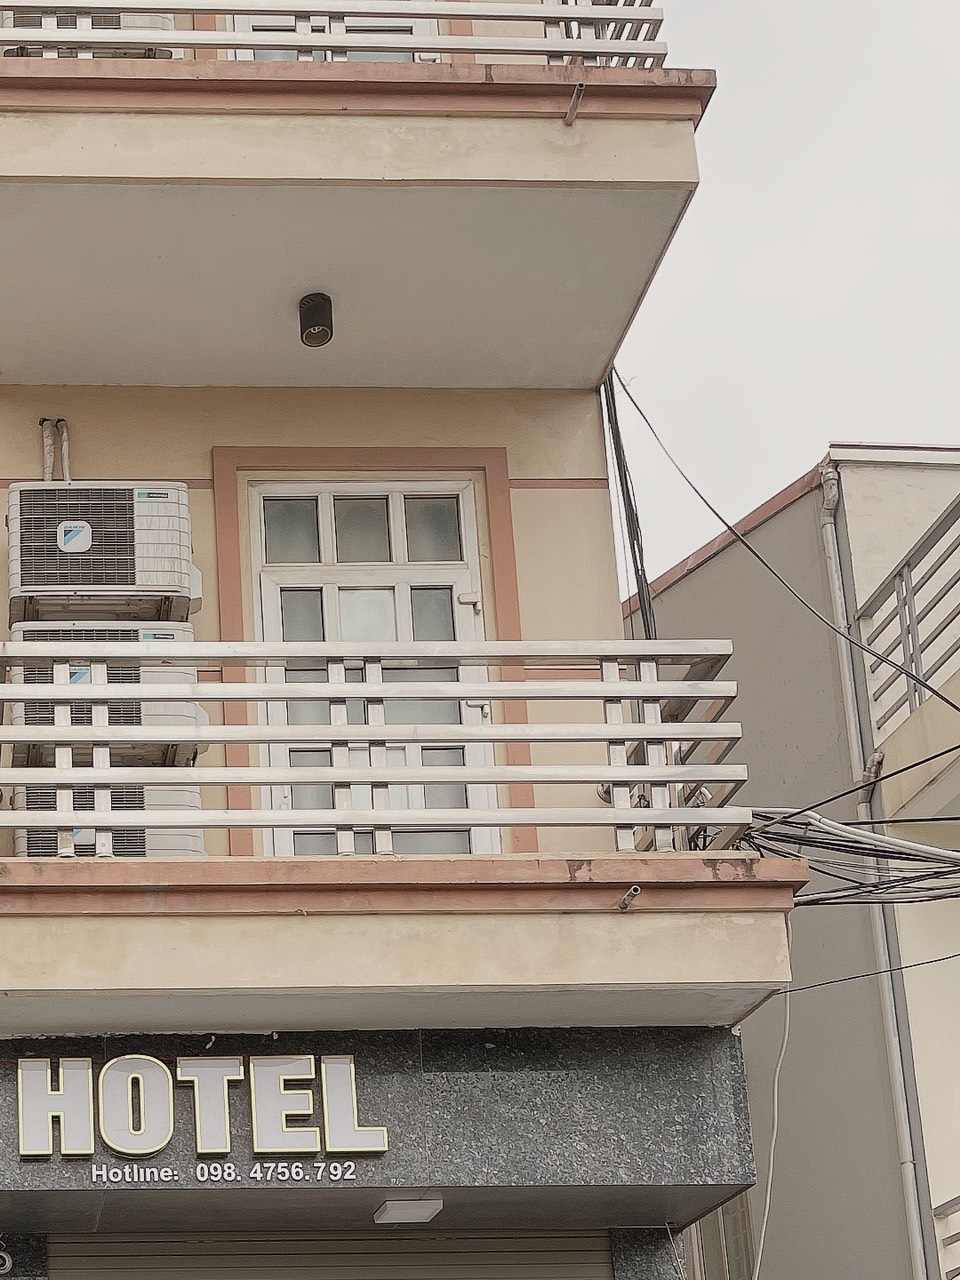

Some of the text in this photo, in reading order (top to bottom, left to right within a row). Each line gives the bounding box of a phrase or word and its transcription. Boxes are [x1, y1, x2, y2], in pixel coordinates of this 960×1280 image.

[17, 1054, 388, 1158] HOTEL
[91, 1161, 357, 1183] Hotline: 098. 4756.792
